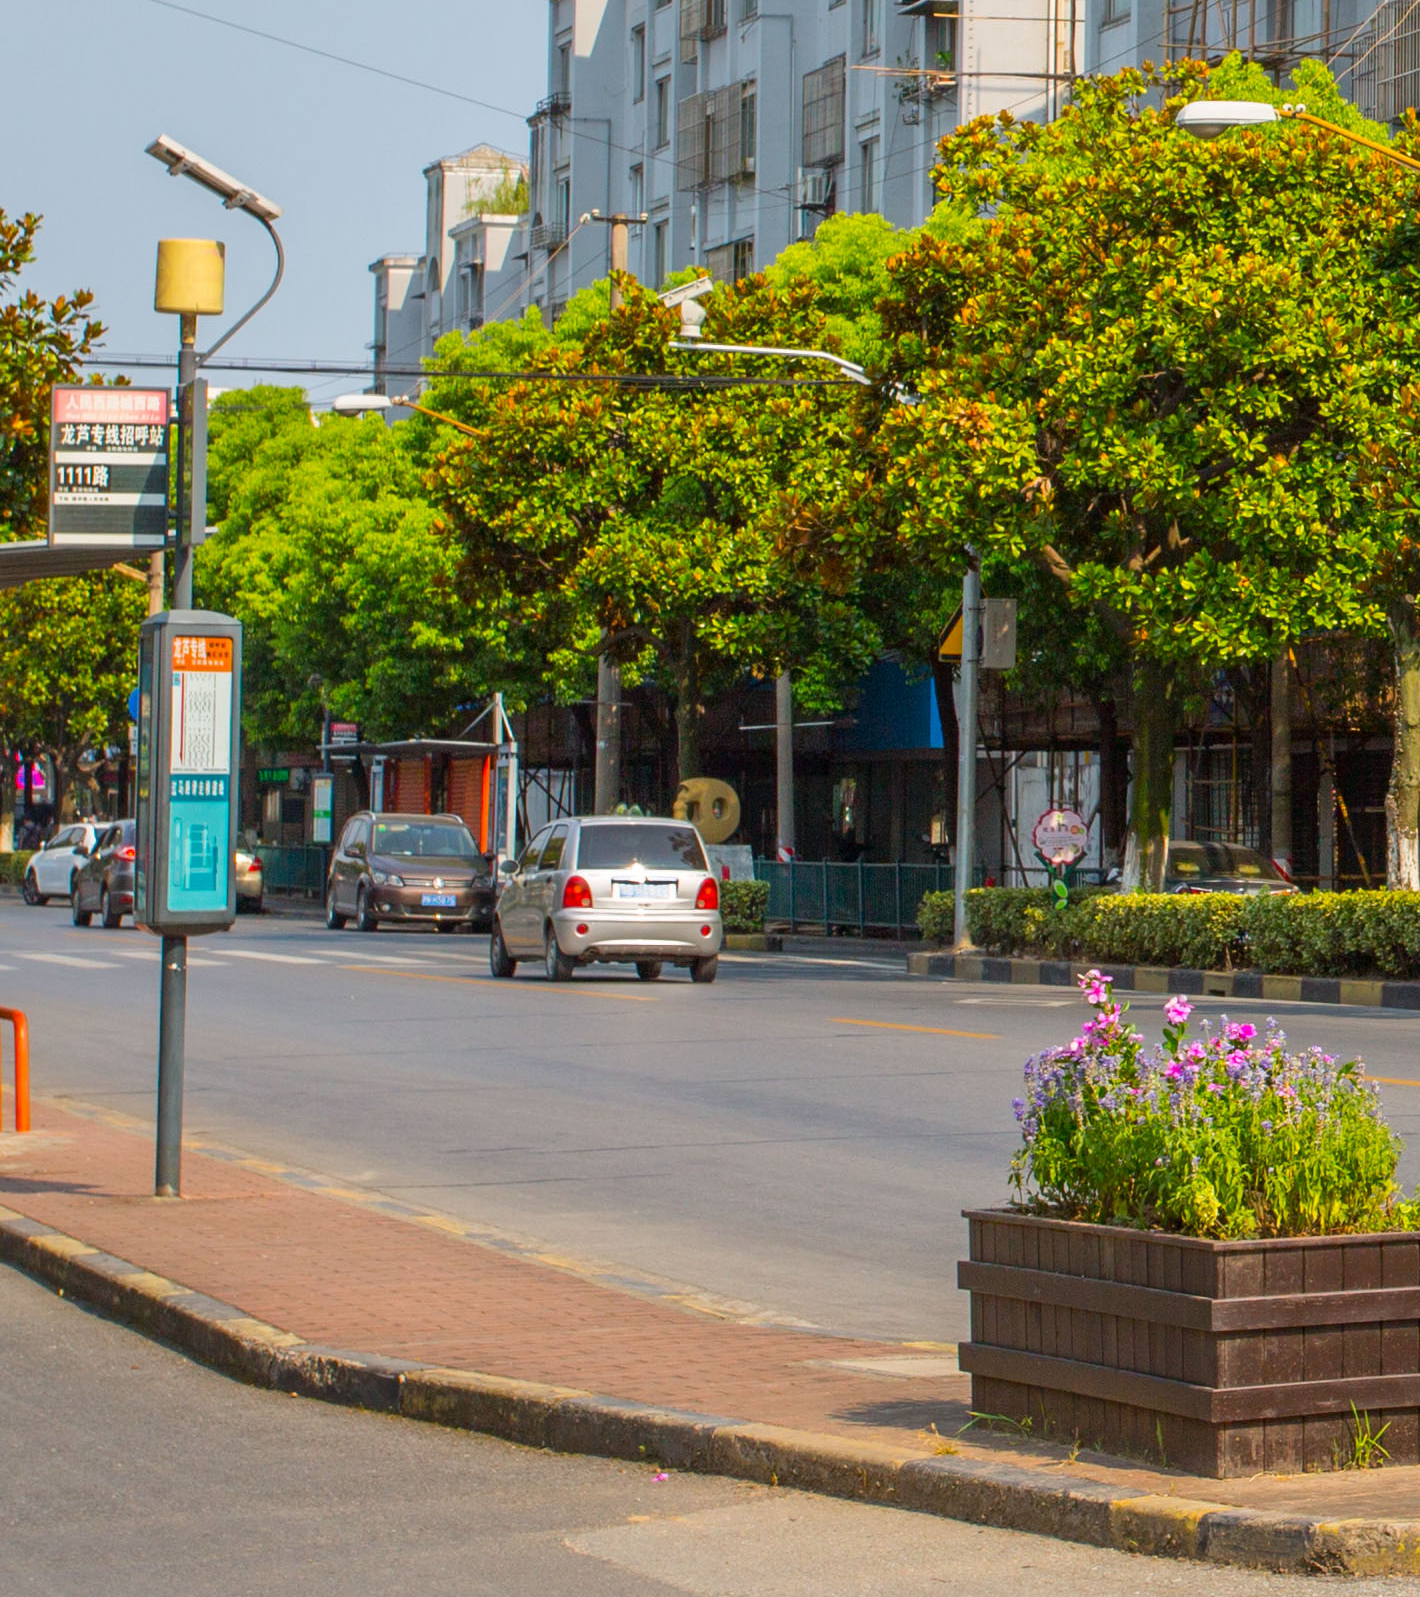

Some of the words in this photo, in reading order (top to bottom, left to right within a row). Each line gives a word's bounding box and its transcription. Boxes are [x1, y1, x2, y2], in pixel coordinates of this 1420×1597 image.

[61, 423, 164, 446] 龙芦专线招呼站
[57, 465, 108, 487] 1111路
